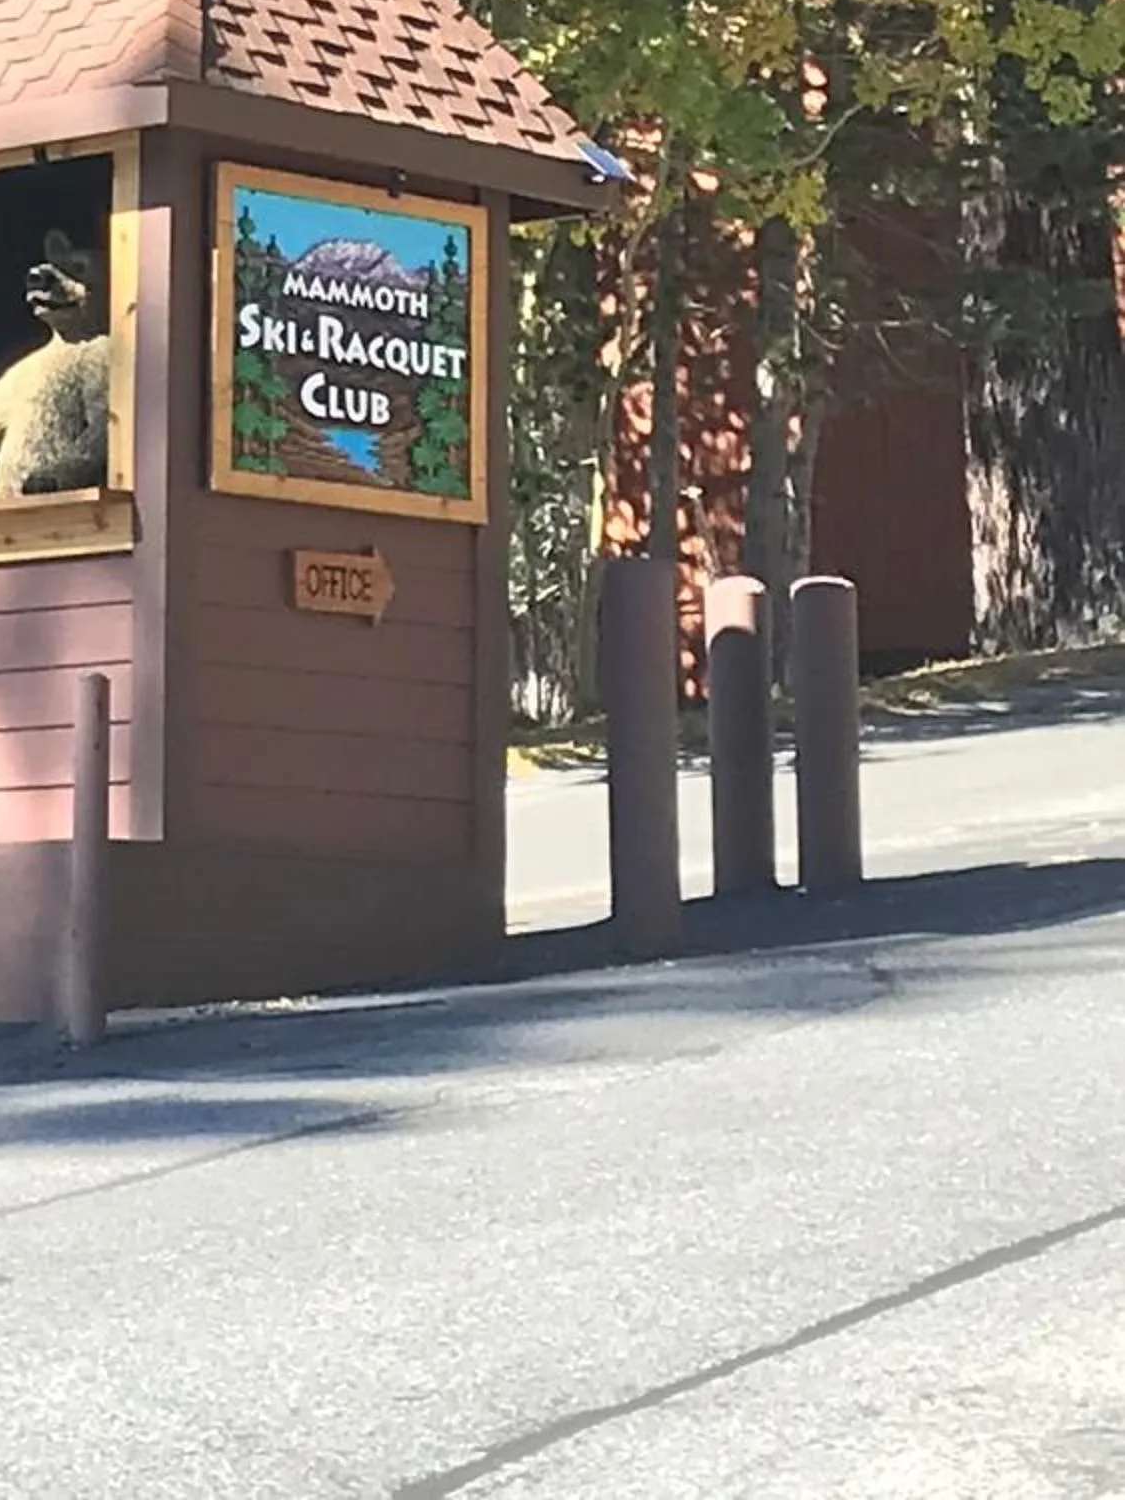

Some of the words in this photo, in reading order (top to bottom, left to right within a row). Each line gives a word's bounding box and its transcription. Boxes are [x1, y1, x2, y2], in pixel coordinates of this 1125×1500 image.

[282, 271, 429, 319] MAMMOTH
[238, 302, 297, 356] SKI
[300, 329, 315, 353] &
[317, 314, 467, 379] RACQUET
[299, 371, 392, 426] CLUB
[304, 562, 373, 602] OFFICE
